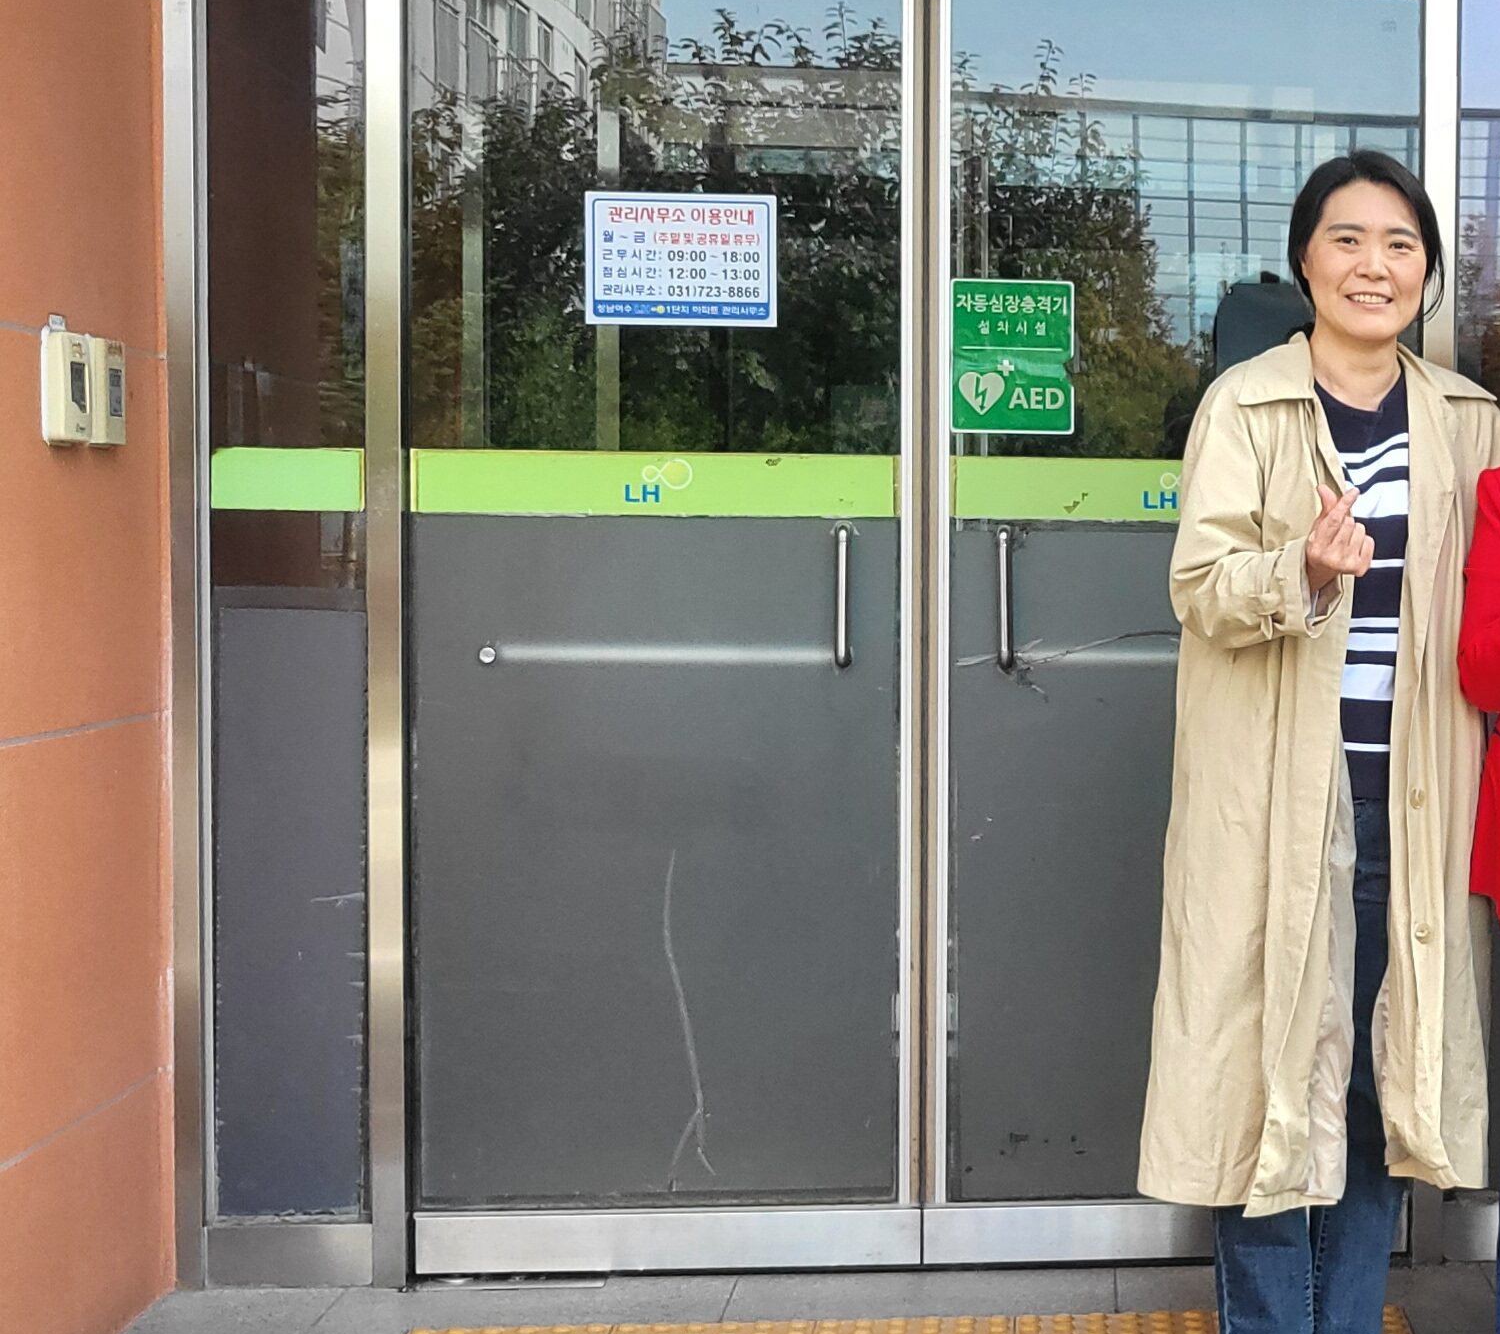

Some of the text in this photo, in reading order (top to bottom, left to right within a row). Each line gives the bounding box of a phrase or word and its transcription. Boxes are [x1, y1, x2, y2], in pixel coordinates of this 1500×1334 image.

[608, 206, 754, 225] 관리사무소 이용안내
[602, 230, 614, 243] 월
[634, 231, 646, 244] 금
[668, 250, 707, 262] 09:00
[722, 251, 760, 263] 18:00
[668, 267, 707, 280] 12:00
[722, 269, 760, 281] 13:00
[668, 285, 760, 298] 031)723-8866
[956, 293, 1068, 316] 자동심장충격기
[1008, 387, 1065, 410] AED
[624, 484, 660, 503] LH
[1143, 490, 1177, 509] LH
